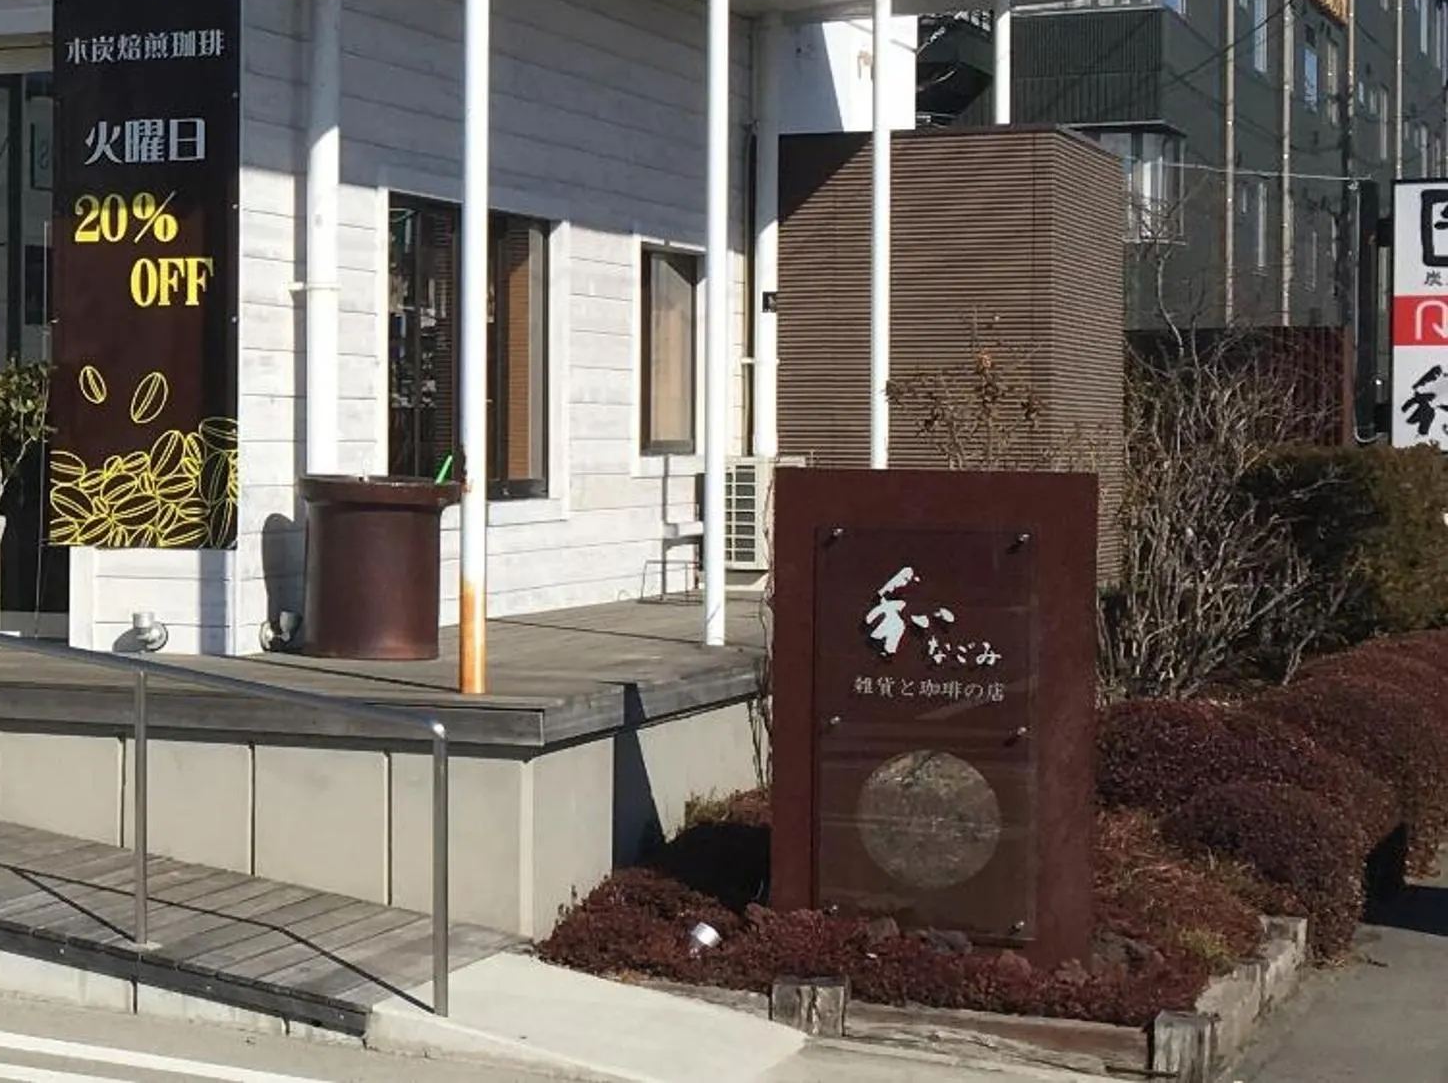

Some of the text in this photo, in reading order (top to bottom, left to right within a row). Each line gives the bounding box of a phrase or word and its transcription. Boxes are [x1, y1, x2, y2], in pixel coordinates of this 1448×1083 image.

[65, 28, 225, 65] 木炭焙煎珈琲
[84, 118, 206, 166] 火曜日
[74, 191, 178, 244] 20%
[130, 257, 214, 307] OFF
[926, 636, 1002, 667] なごみ
[853, 676, 1006, 703] 雑貨と珈琲の店
